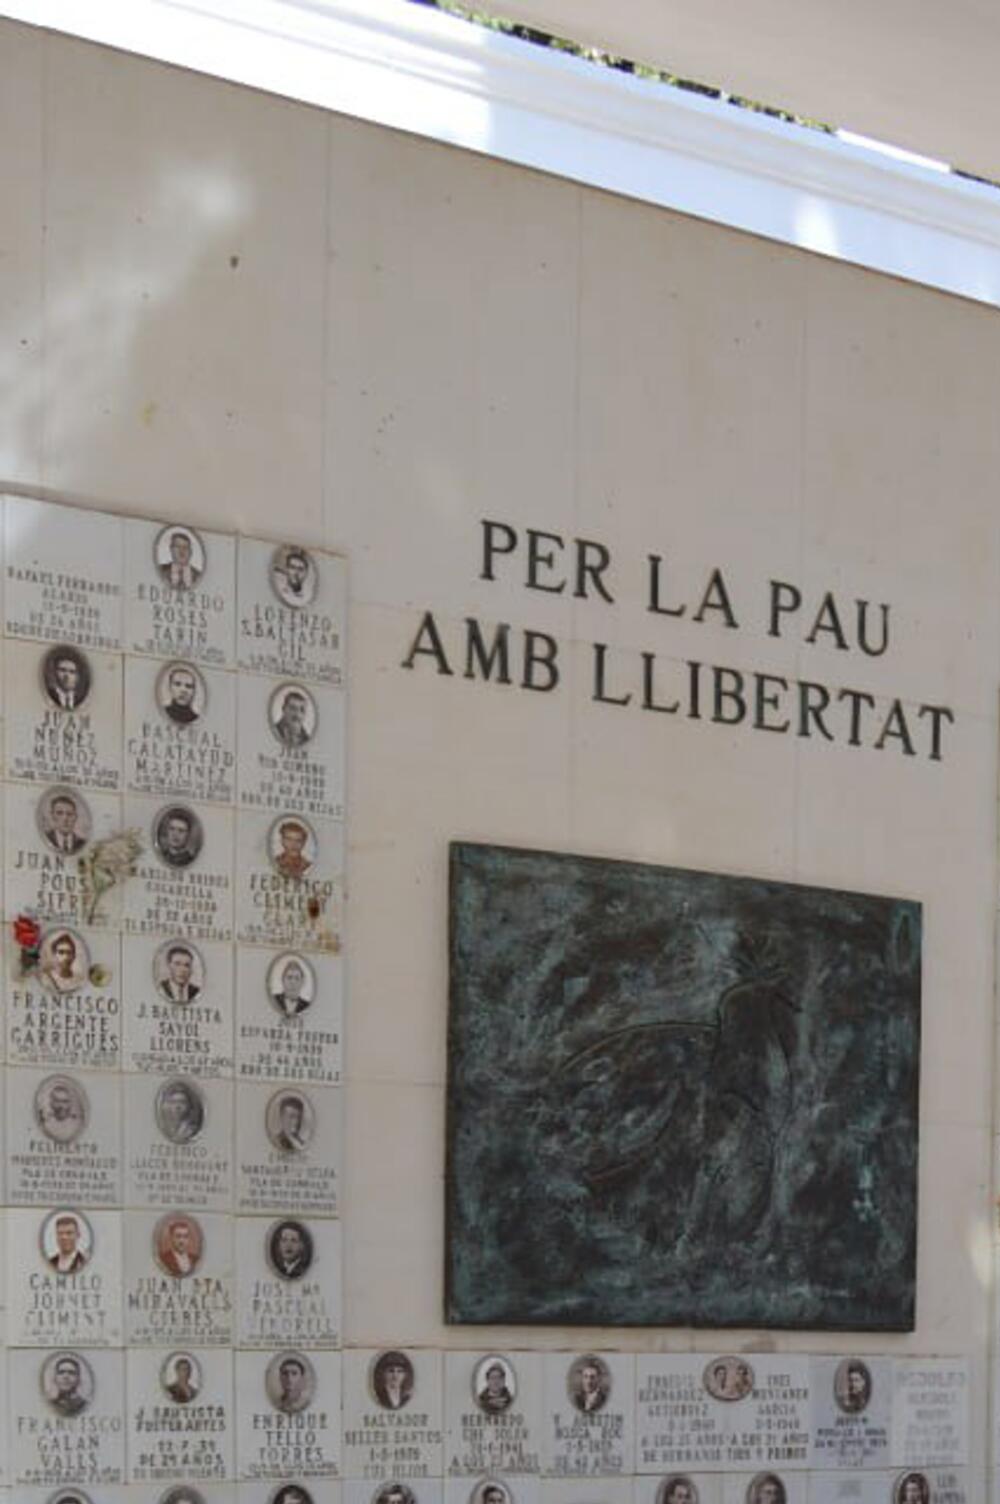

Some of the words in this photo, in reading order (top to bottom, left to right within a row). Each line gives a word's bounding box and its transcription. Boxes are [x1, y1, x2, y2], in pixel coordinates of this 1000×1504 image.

[480, 520, 614, 604] PER
[648, 555, 738, 629] LA
[768, 580, 891, 658] PAU
[401, 610, 560, 693] AMB
[591, 643, 954, 762] LLIBERTAT
[16, 850, 65, 871] JUAN
[13, 991, 119, 1015] FRANCISCO
[25, 1012, 109, 1033] ARGENTE
[12, 1027, 119, 1052] GARRIGUES
[30, 1272, 102, 1291] CAMILO
[253, 1413, 328, 1431] ENRIQUE
[37, 1434, 101, 1452] GALAN
[265, 1430, 317, 1447] TELLO
[259, 1447, 323, 1464] TORRES
